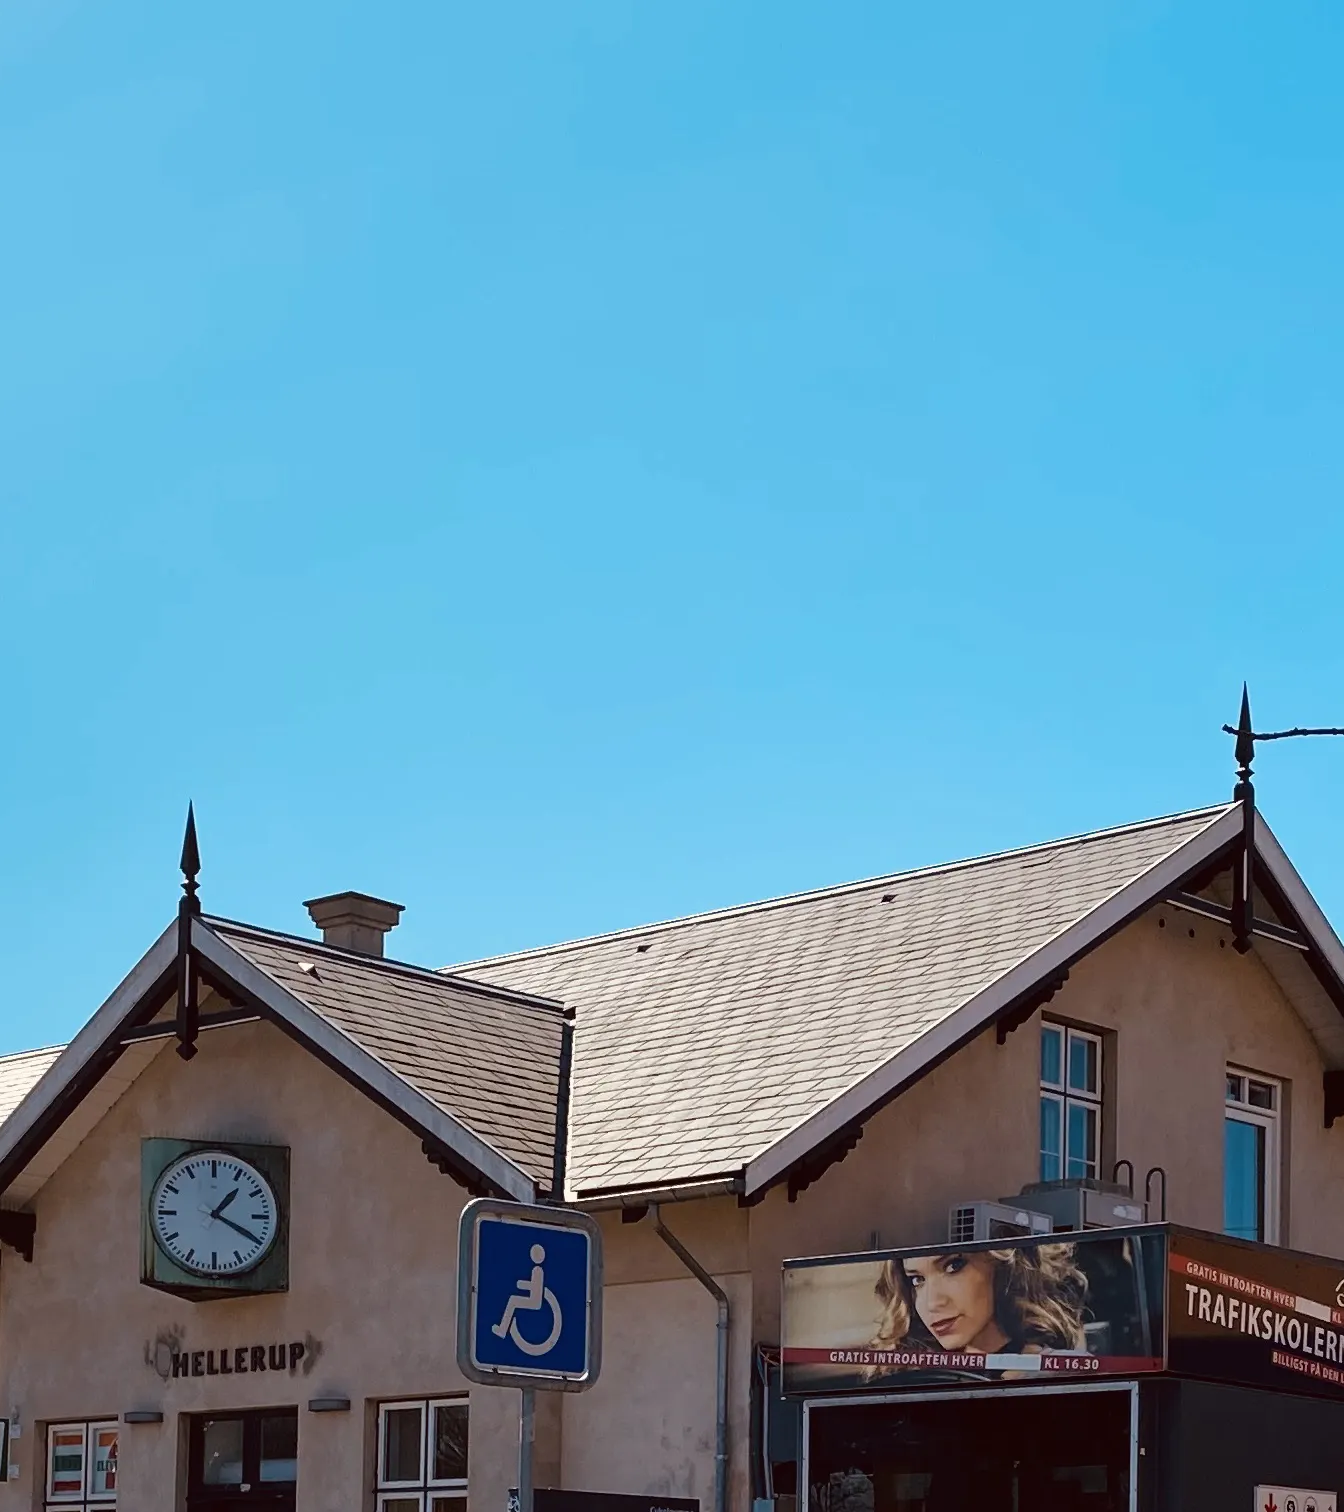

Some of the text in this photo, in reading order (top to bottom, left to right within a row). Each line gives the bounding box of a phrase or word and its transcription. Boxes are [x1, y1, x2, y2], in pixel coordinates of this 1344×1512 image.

[1186, 1261, 1217, 1282] GRATIS
[1219, 1272, 1272, 1300] INTROAFTEN
[1273, 1292, 1295, 1309] HVER
[1331, 1311, 1342, 1323] KL
[171, 1342, 305, 1379] HELLERUP
[830, 1351, 1100, 1370] GRATIS INTROAFTEN HVER KL 16.30
[1272, 1351, 1308, 1373] BILLIGST
[1310, 1360, 1321, 1377] PÅ
[1323, 1367, 1339, 1383] DEN
